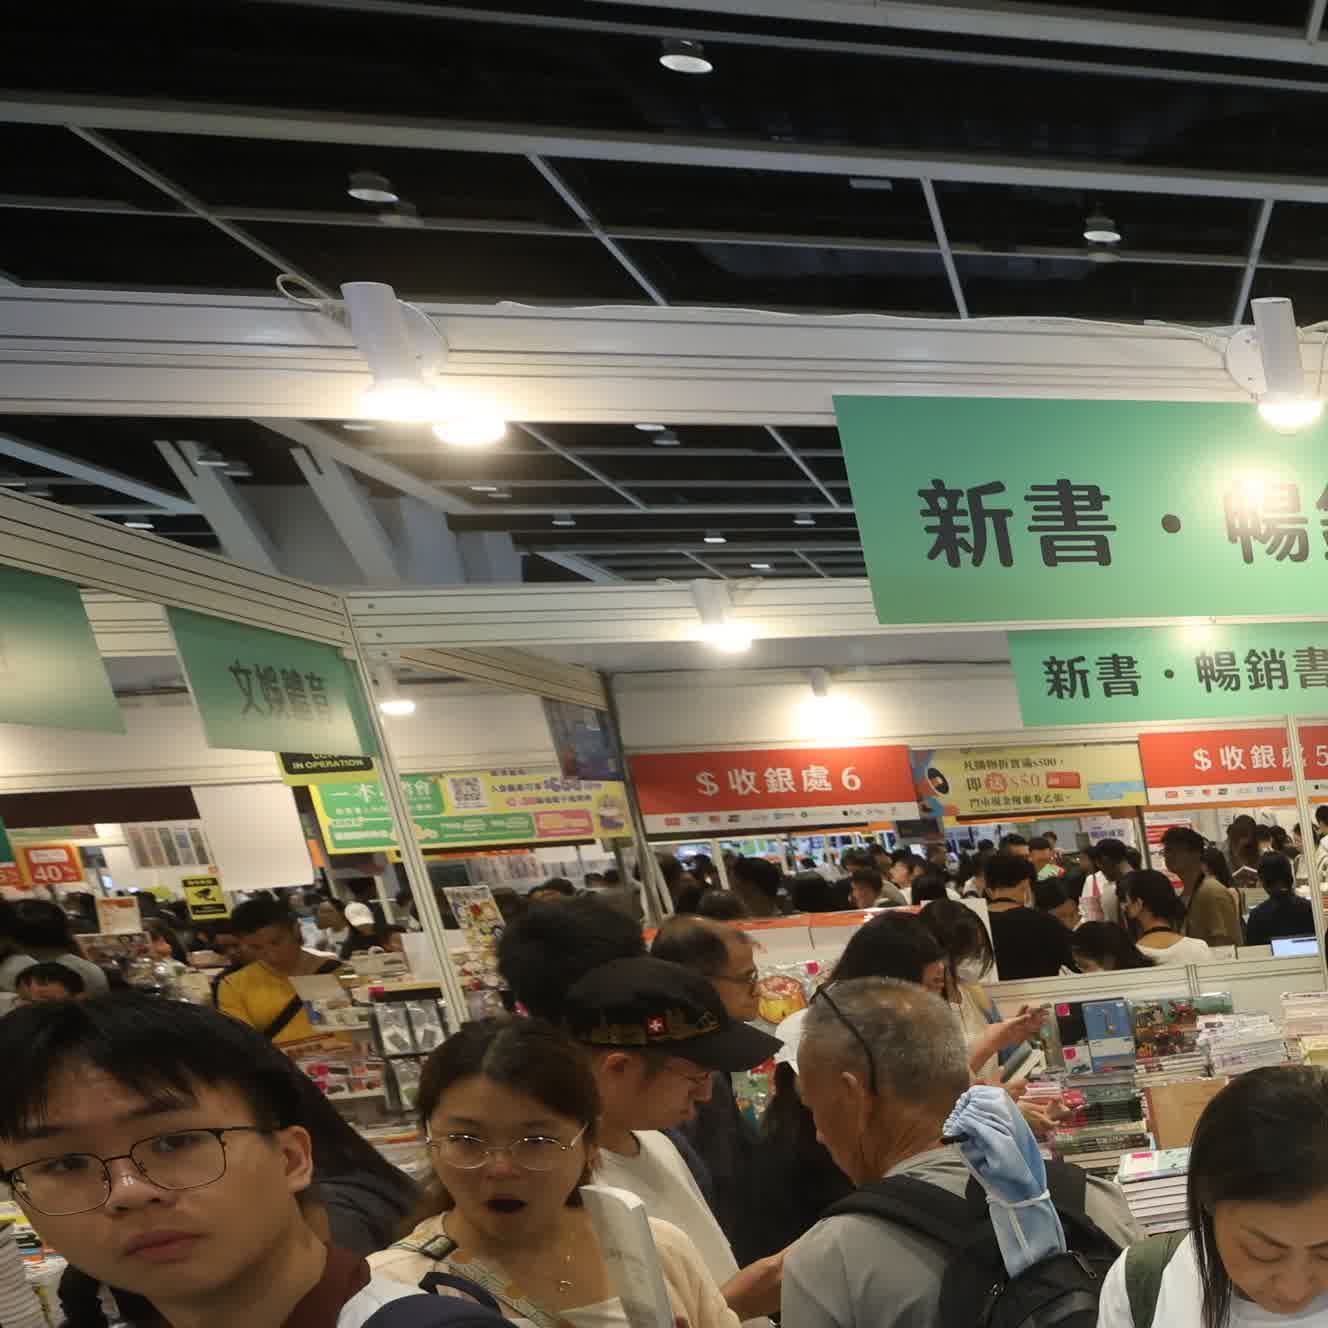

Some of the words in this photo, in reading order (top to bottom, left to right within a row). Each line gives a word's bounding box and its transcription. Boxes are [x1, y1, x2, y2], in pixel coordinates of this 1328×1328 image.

[292, 761, 304, 770] IN
[305, 758, 364, 770] OPERATION
[727, 764, 833, 796] 收銀處
[841, 766, 862, 791] 6
[34, 866, 63, 881] 40
